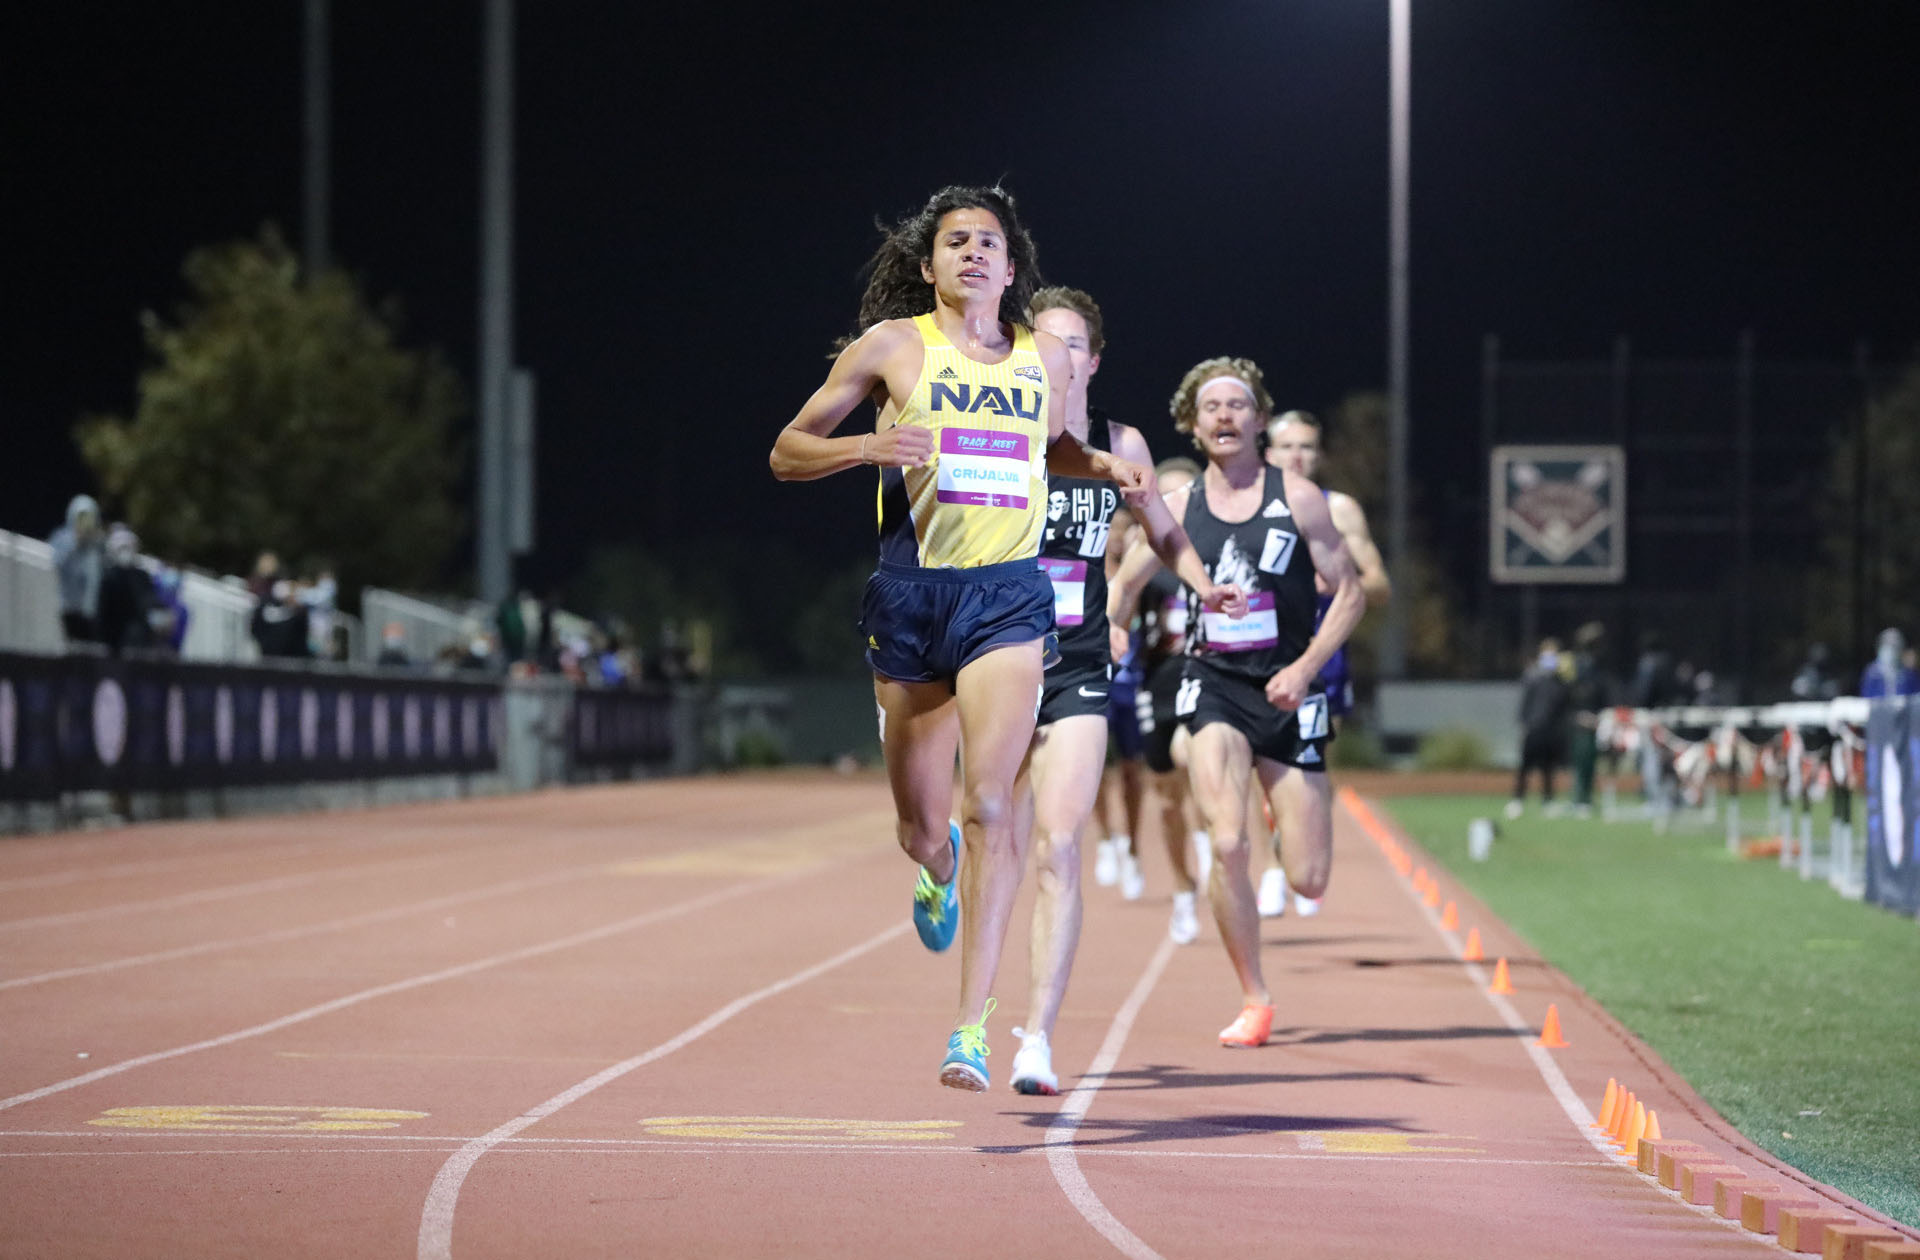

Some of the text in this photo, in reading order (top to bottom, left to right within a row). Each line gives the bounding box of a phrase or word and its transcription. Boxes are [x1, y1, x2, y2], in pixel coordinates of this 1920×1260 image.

[929, 382, 1042, 422] NAU
[957, 435, 1018, 450] TRACK MEET
[1272, 535, 1291, 568] 7
[1304, 697, 1322, 734] 7
